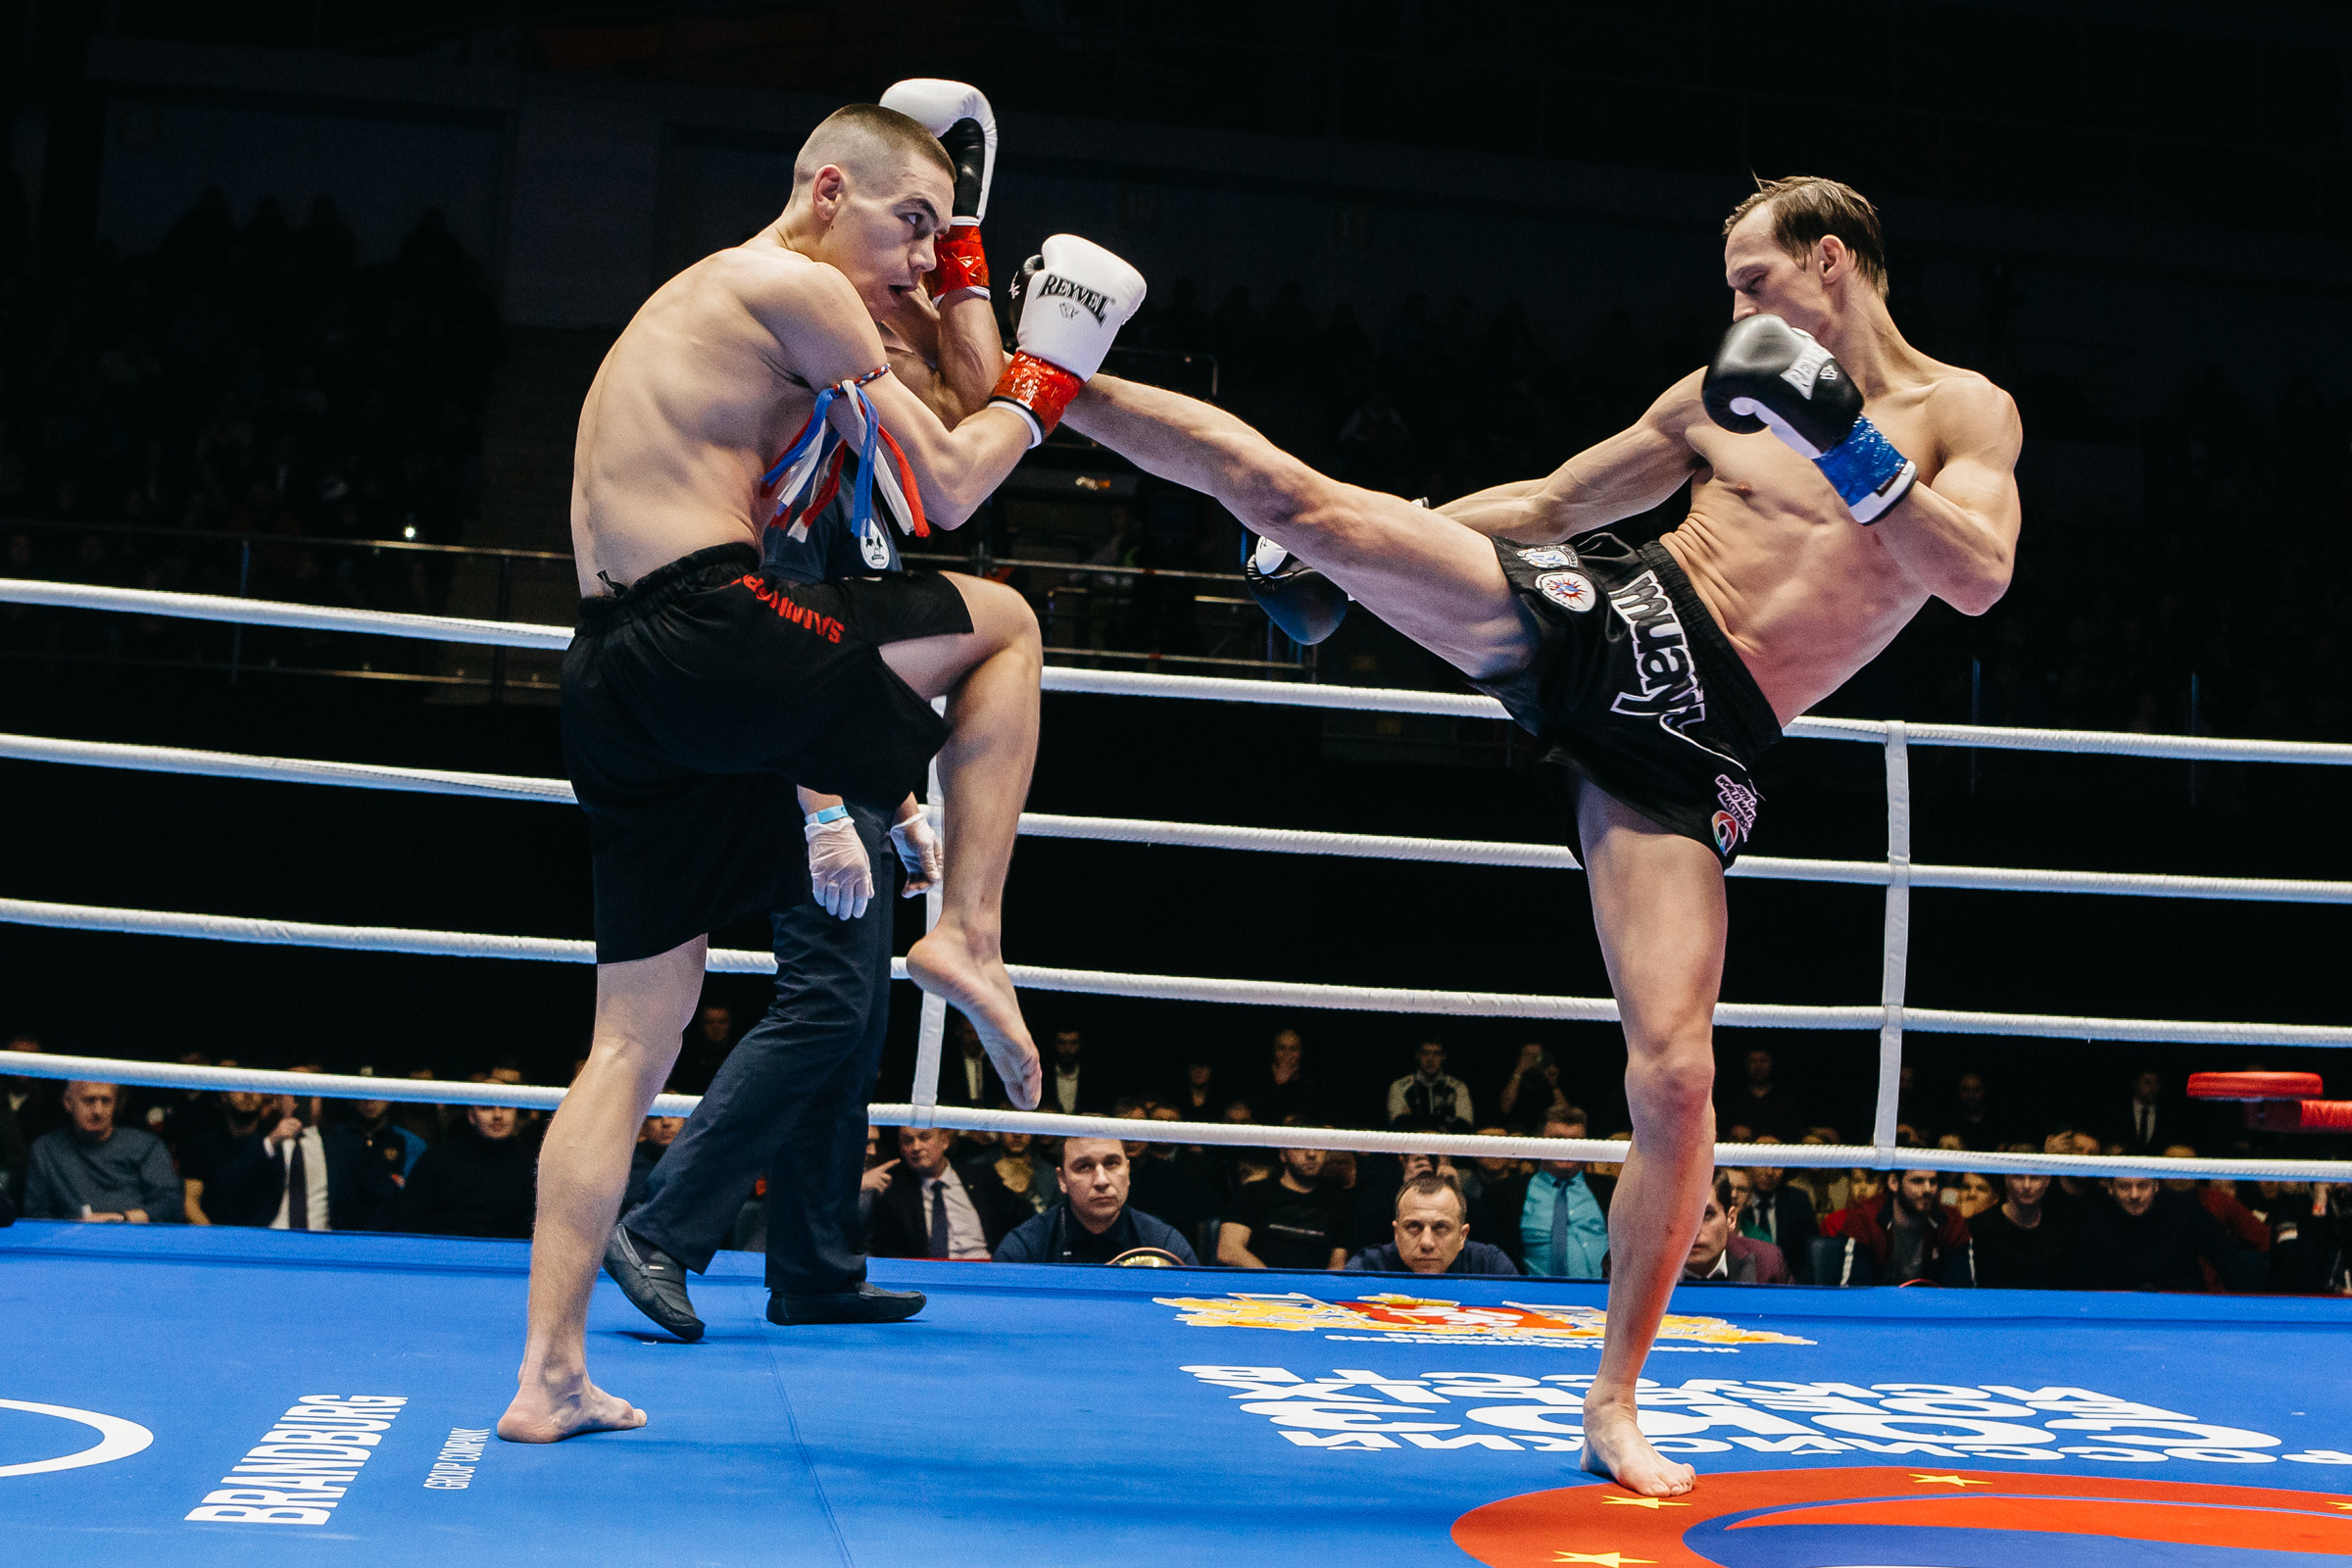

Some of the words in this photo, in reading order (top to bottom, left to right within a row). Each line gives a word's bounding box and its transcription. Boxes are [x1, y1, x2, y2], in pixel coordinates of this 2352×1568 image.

[1036, 273, 1110, 328] REYVEL
[1717, 775, 1740, 801] WORLD
[1736, 785, 1751, 802] 2019
[1179, 1365, 2127, 1402] ИСКУССТВ
[1198, 1380, 2198, 1421] БОЕВЫХ
[1240, 1401, 2282, 1448] СОЮЗ
[183, 1394, 409, 1526] BRANDBURG
[437, 1427, 491, 1462] COMPANY
[423, 1462, 476, 1490] GROUP
